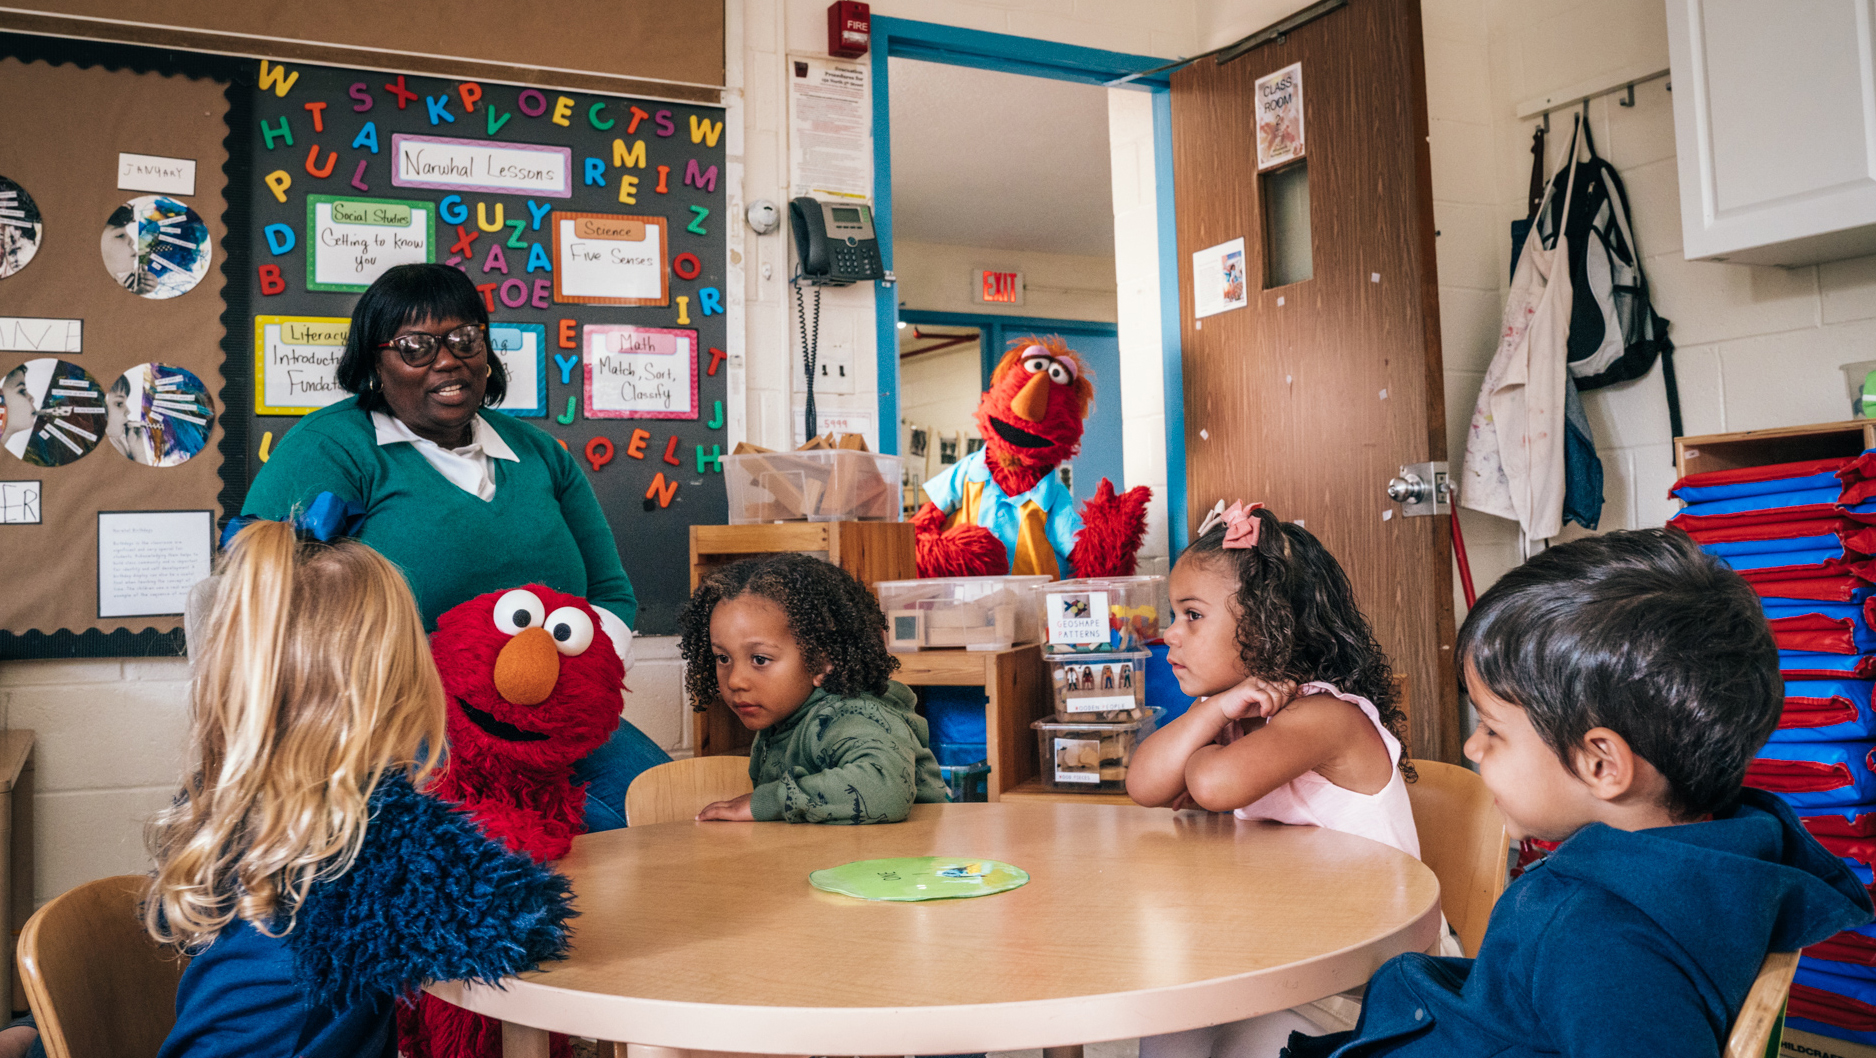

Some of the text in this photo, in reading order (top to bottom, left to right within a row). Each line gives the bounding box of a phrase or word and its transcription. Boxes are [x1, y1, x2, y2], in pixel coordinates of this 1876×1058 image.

[847, 20, 868, 31] FIRE
[259, 59, 299, 97] W
[385, 76, 418, 109] X
[1263, 76, 1293, 98] CLASS
[350, 83, 372, 111] S
[426, 94, 455, 125] K
[458, 82, 482, 113] P
[519, 90, 546, 116] O
[552, 96, 574, 127] E
[1264, 93, 1293, 114] ROOM
[304, 102, 327, 132] T
[487, 105, 511, 135] V
[589, 102, 614, 130] C
[627, 106, 649, 134] T
[656, 110, 674, 136] S
[689, 115, 723, 147] W
[260, 116, 293, 149] H
[352, 121, 379, 154] A
[305, 144, 338, 178] U
[405, 148, 555, 181] Narwhal Lessons
[612, 139, 646, 168] M
[265, 170, 291, 203] P
[352, 160, 367, 190] L
[584, 157, 606, 187] R
[655, 165, 670, 194] I
[685, 159, 717, 191] M
[619, 175, 639, 205] E
[334, 203, 410, 225] Social Studies
[439, 194, 468, 225] G
[477, 202, 504, 232] U
[527, 200, 551, 231] Y
[687, 205, 709, 235] Z
[264, 223, 296, 256] D
[321, 227, 424, 255] Getting to know
[450, 226, 479, 259] X
[505, 220, 528, 248] Z
[584, 220, 632, 237] Science
[355, 255, 377, 273] you
[484, 245, 507, 273] A
[526, 243, 552, 273] A
[570, 242, 653, 266] Five Senses
[673, 252, 701, 280] O
[258, 264, 285, 295] B
[983, 270, 1017, 303] EXIT
[676, 296, 690, 325] I
[698, 287, 724, 316] R
[290, 324, 349, 346] Literacy
[559, 319, 577, 349] E
[620, 333, 656, 352] Math
[273, 344, 342, 367] Introducti
[554, 354, 579, 384] Y
[708, 347, 727, 375] T
[287, 369, 341, 396] Fundat
[621, 380, 671, 409] Classify
[557, 396, 576, 424] J
[707, 401, 723, 429] J
[585, 436, 614, 471] Q
[627, 428, 650, 459] E
[663, 435, 680, 465] L
[696, 445, 721, 473] H
[645, 472, 678, 508] N
[1056, 619, 1100, 629] GEOSHAPE
[1058, 630, 1100, 639] PATTERNS
